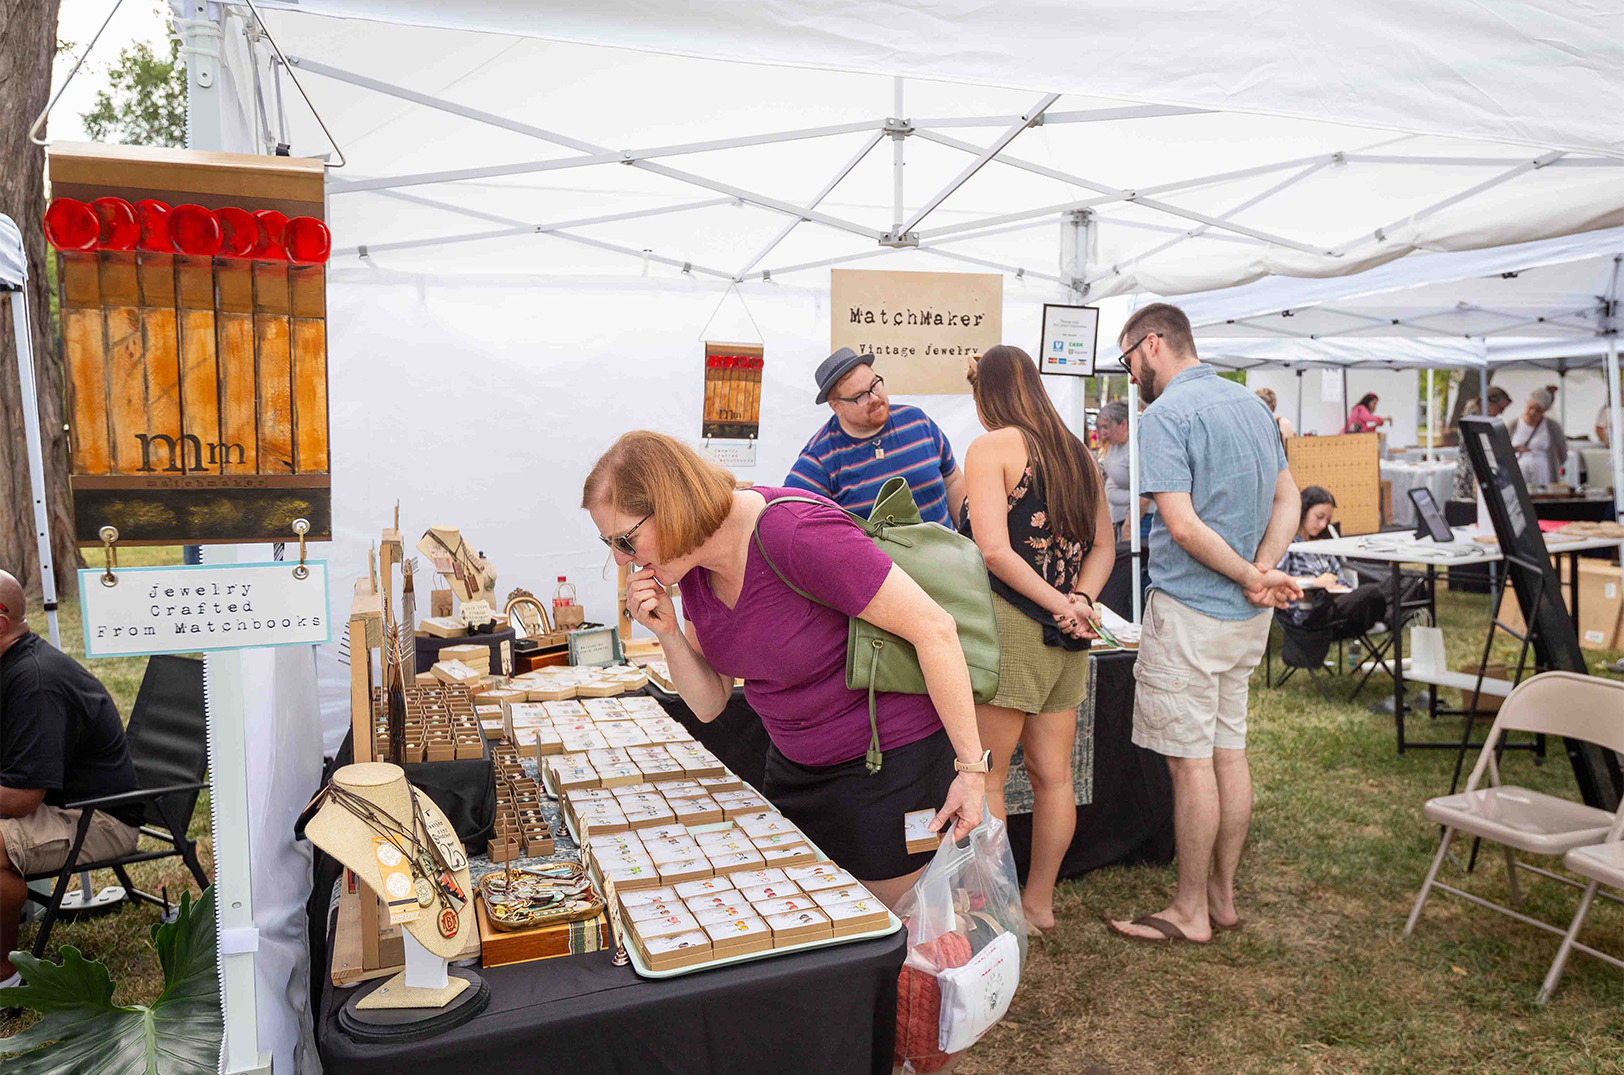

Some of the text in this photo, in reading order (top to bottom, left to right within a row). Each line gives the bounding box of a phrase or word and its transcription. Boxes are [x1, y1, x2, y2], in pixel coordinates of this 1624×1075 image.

[849, 307, 985, 328] MatchMaker
[859, 343, 916, 358] Vintage
[146, 478, 268, 489] matchmaker
[149, 582, 253, 600] Jewelry
[150, 601, 254, 617] Crafted
[97, 614, 322, 639] From Matchbooks
